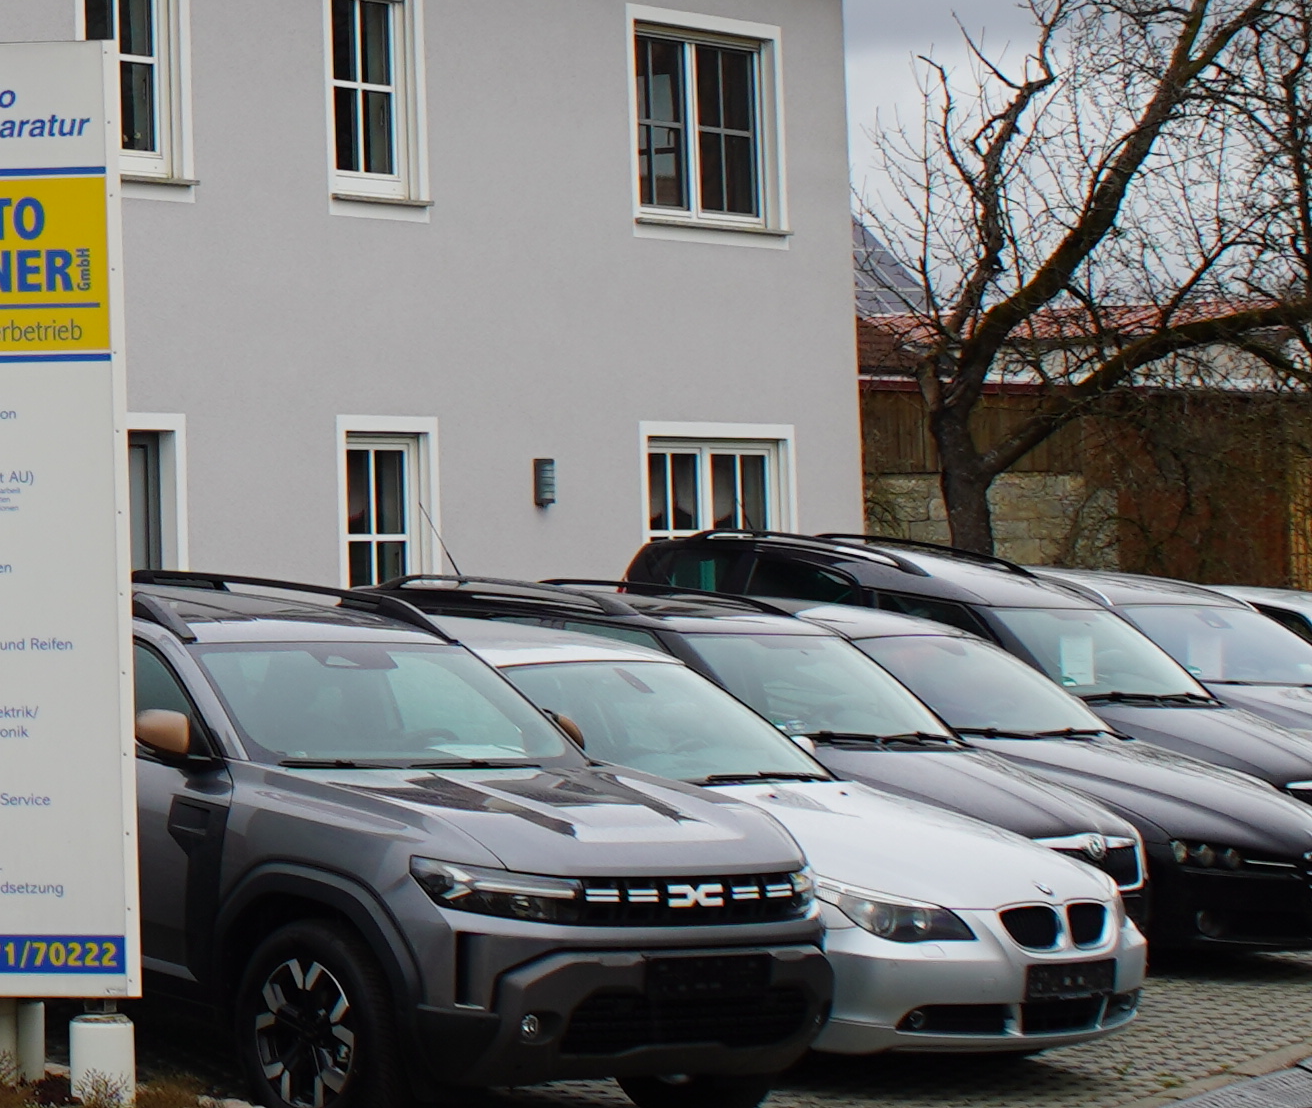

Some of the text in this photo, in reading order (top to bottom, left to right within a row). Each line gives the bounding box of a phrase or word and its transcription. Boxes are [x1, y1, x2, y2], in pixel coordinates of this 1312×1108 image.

[76, 247, 91, 291] GmbH
[9, 470, 34, 486] AU)
[0, 637, 25, 651] und
[30, 637, 73, 651] Reifen
